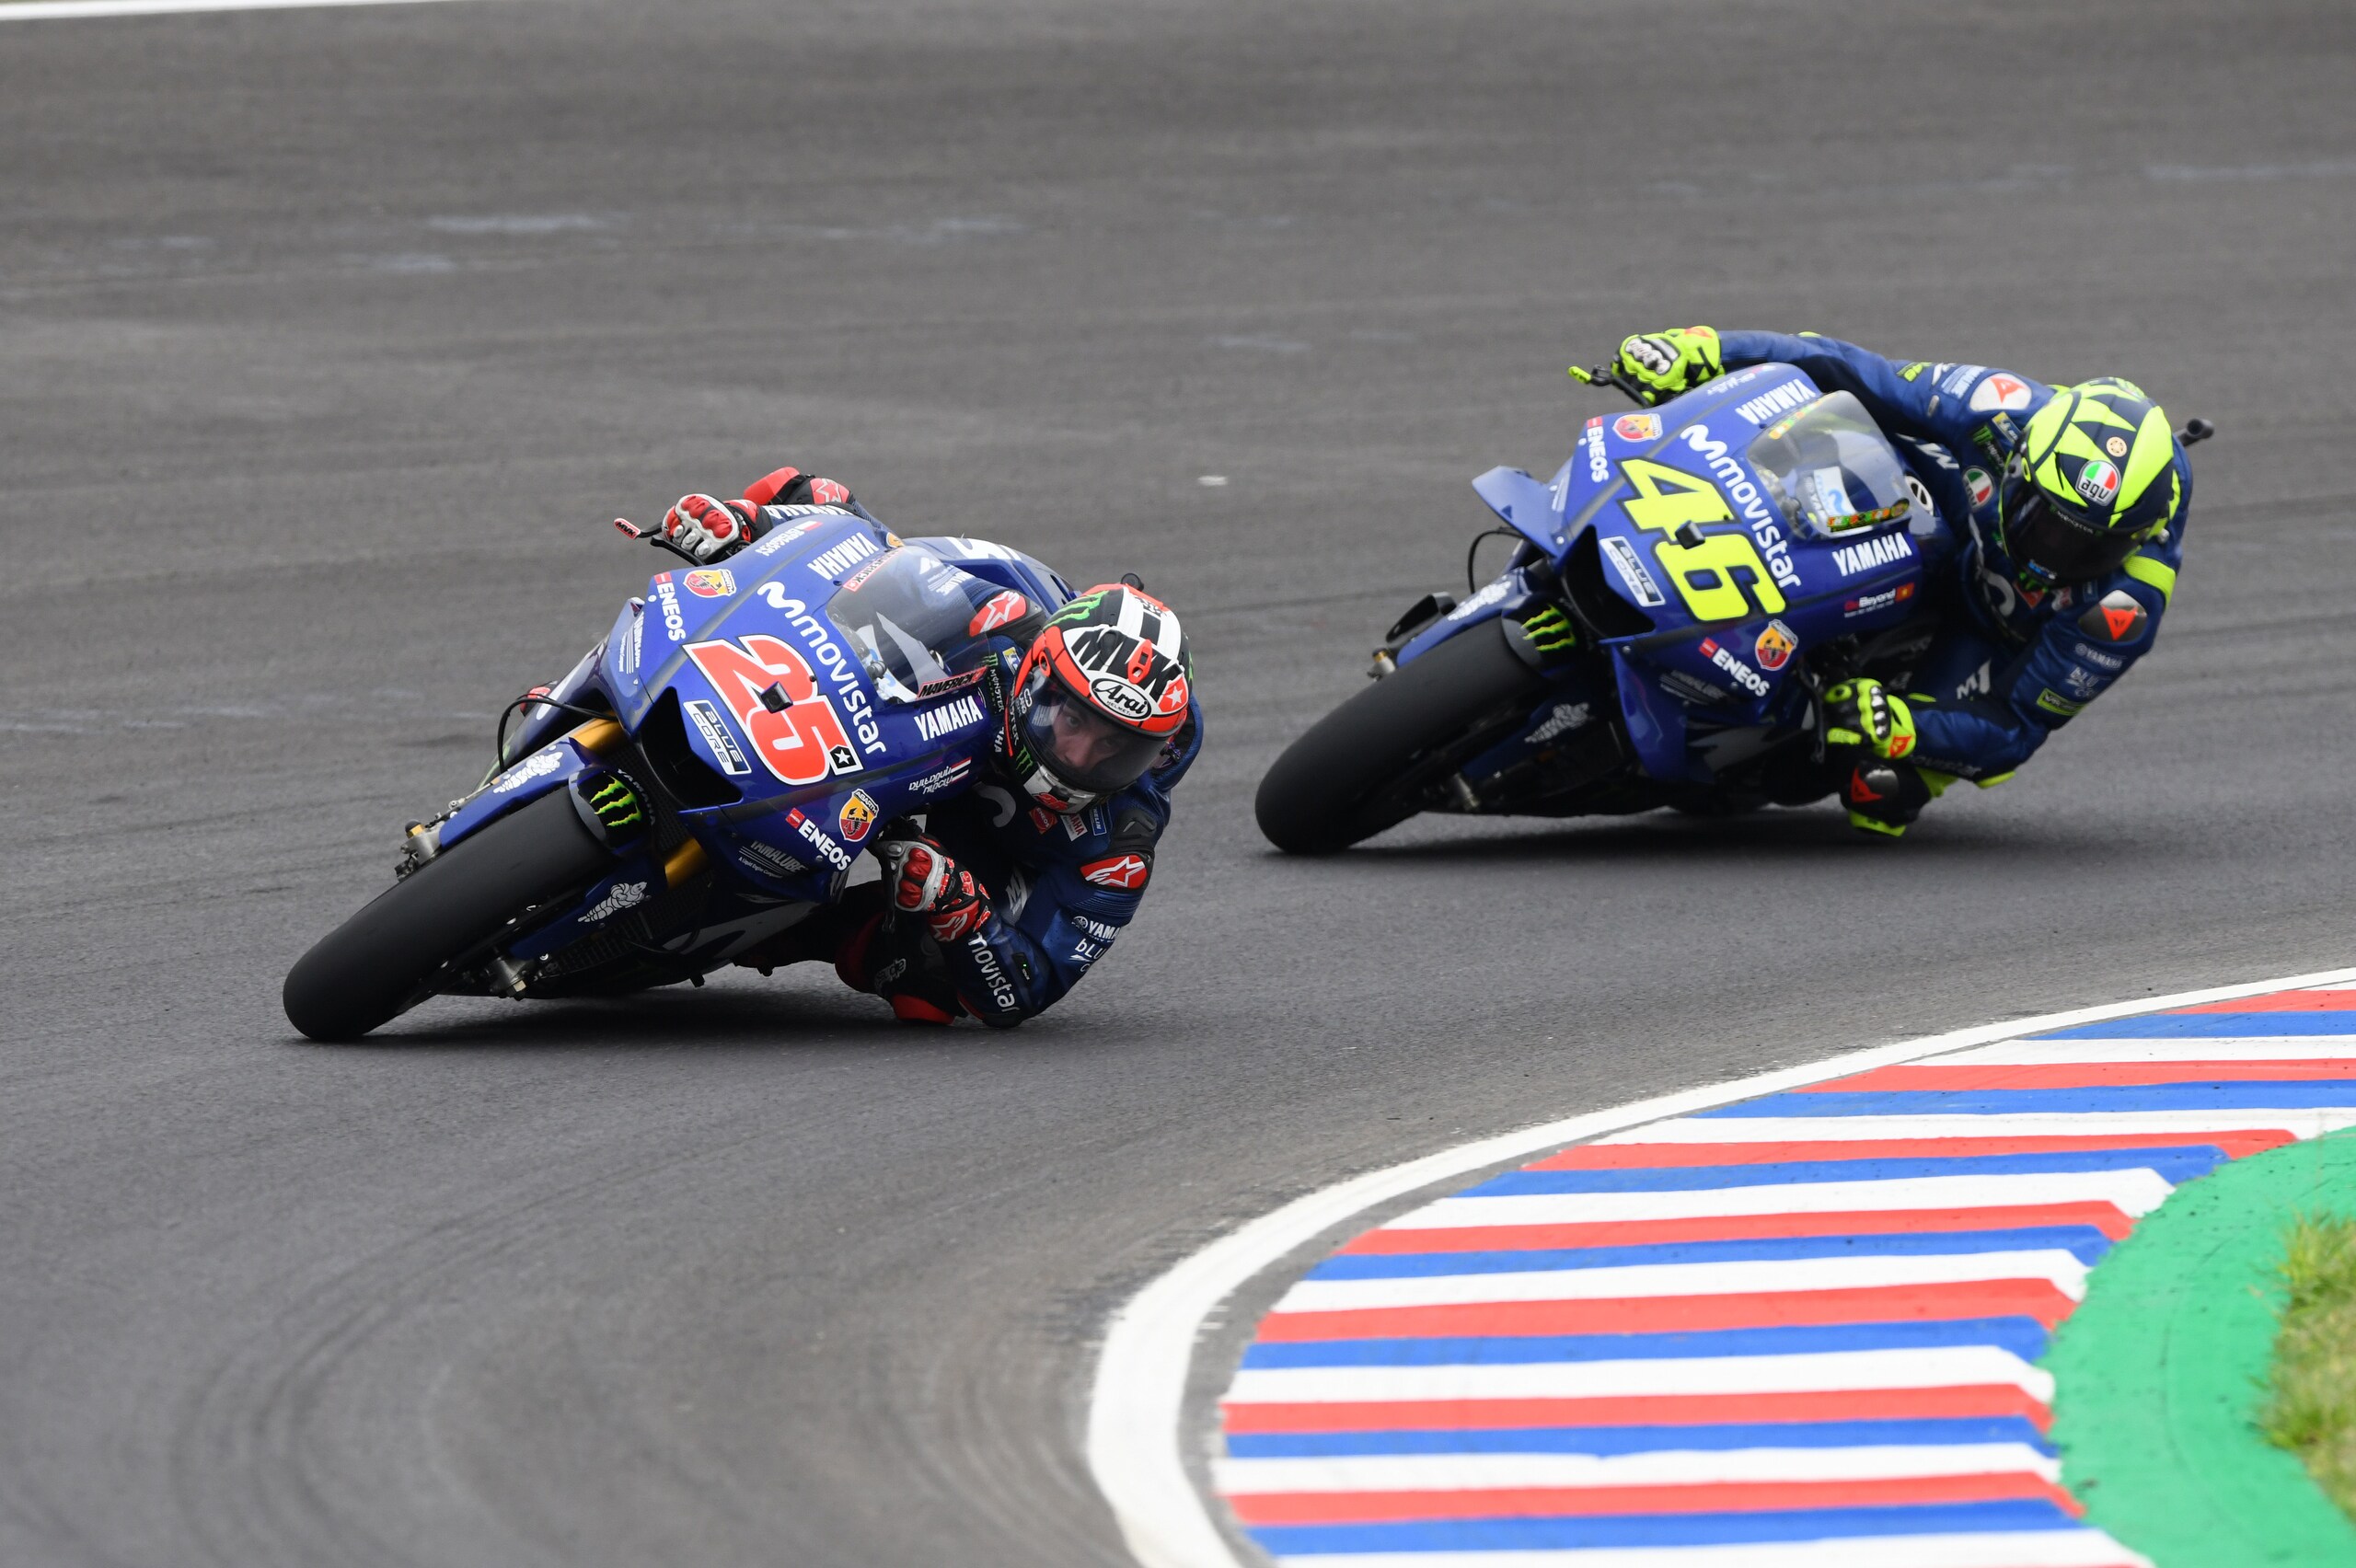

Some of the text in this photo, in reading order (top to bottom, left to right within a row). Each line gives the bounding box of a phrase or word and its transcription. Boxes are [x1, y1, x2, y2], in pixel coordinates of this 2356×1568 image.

[1736, 378, 1816, 424] YAMAHA
[1587, 426, 1609, 482] ENEOS
[1620, 458, 1786, 622] 46
[1709, 457, 1801, 588] movistar
[807, 532, 879, 580] YAMAHA
[1620, 546, 1655, 597] BLUE
[1831, 532, 1912, 576] YAMAHA
[656, 582, 686, 641] ENEOS
[791, 615, 886, 754] movistar
[920, 674, 974, 698] MAVERICK
[990, 669, 1005, 712] MONSTER
[1712, 647, 1770, 697] ENEOS
[682, 634, 863, 785] 25
[914, 695, 984, 742] YAMAHA
[1093, 683, 1148, 714] Arai
[693, 713, 729, 763] CORE
[705, 710, 743, 763] BLUE
[855, 790, 879, 814] ABARTH
[1036, 807, 1050, 828] ENEOS
[798, 818, 852, 870] ENEOS
